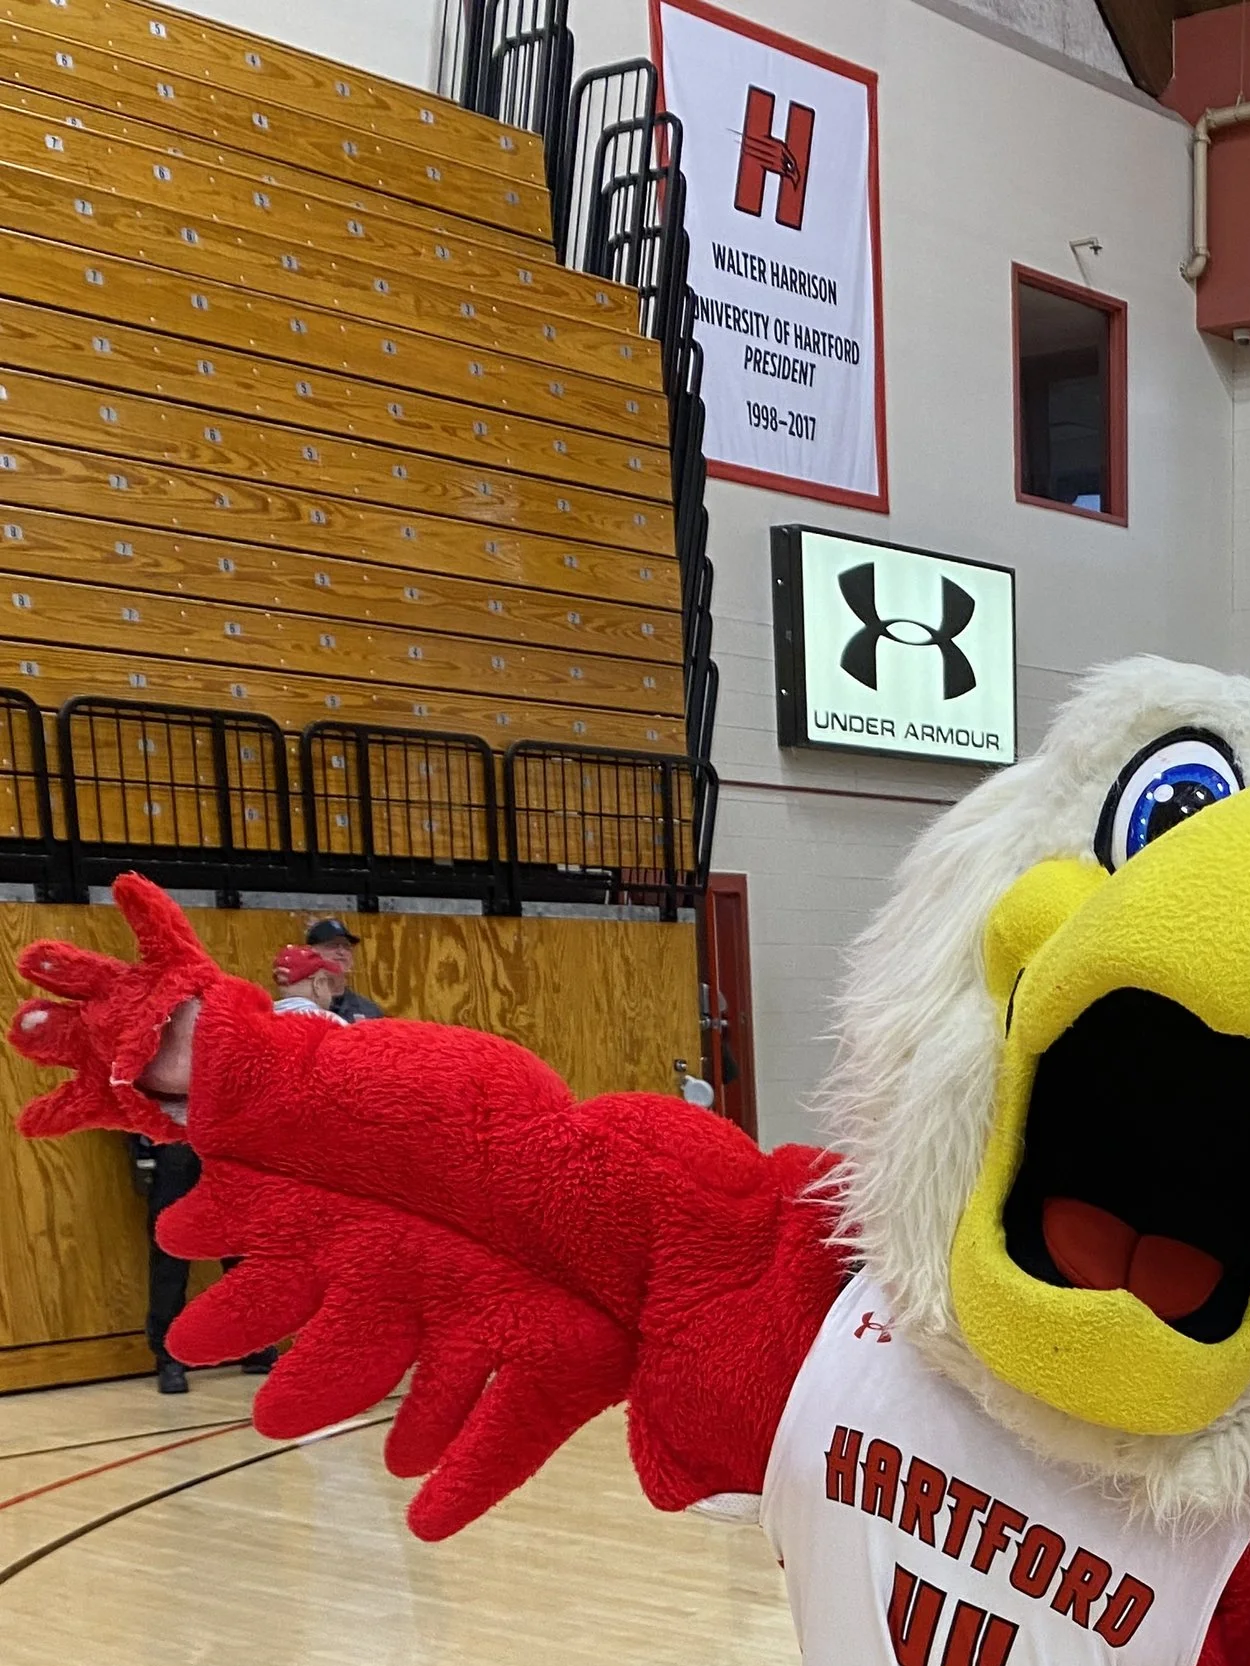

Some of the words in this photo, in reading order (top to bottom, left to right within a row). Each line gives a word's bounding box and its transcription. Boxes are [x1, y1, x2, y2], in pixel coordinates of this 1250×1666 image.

[711, 241, 767, 285] WALTER
[770, 260, 838, 306] HARRISON
[694, 295, 769, 340] UNIVERSITY
[774, 317, 790, 346] OF
[794, 323, 860, 366] HARTFORD
[743, 344, 816, 388] PRESIDENT
[813, 710, 896, 737] UNDER
[903, 721, 1000, 750] ARMOUR
[824, 1425, 1156, 1649] HARTFORD
